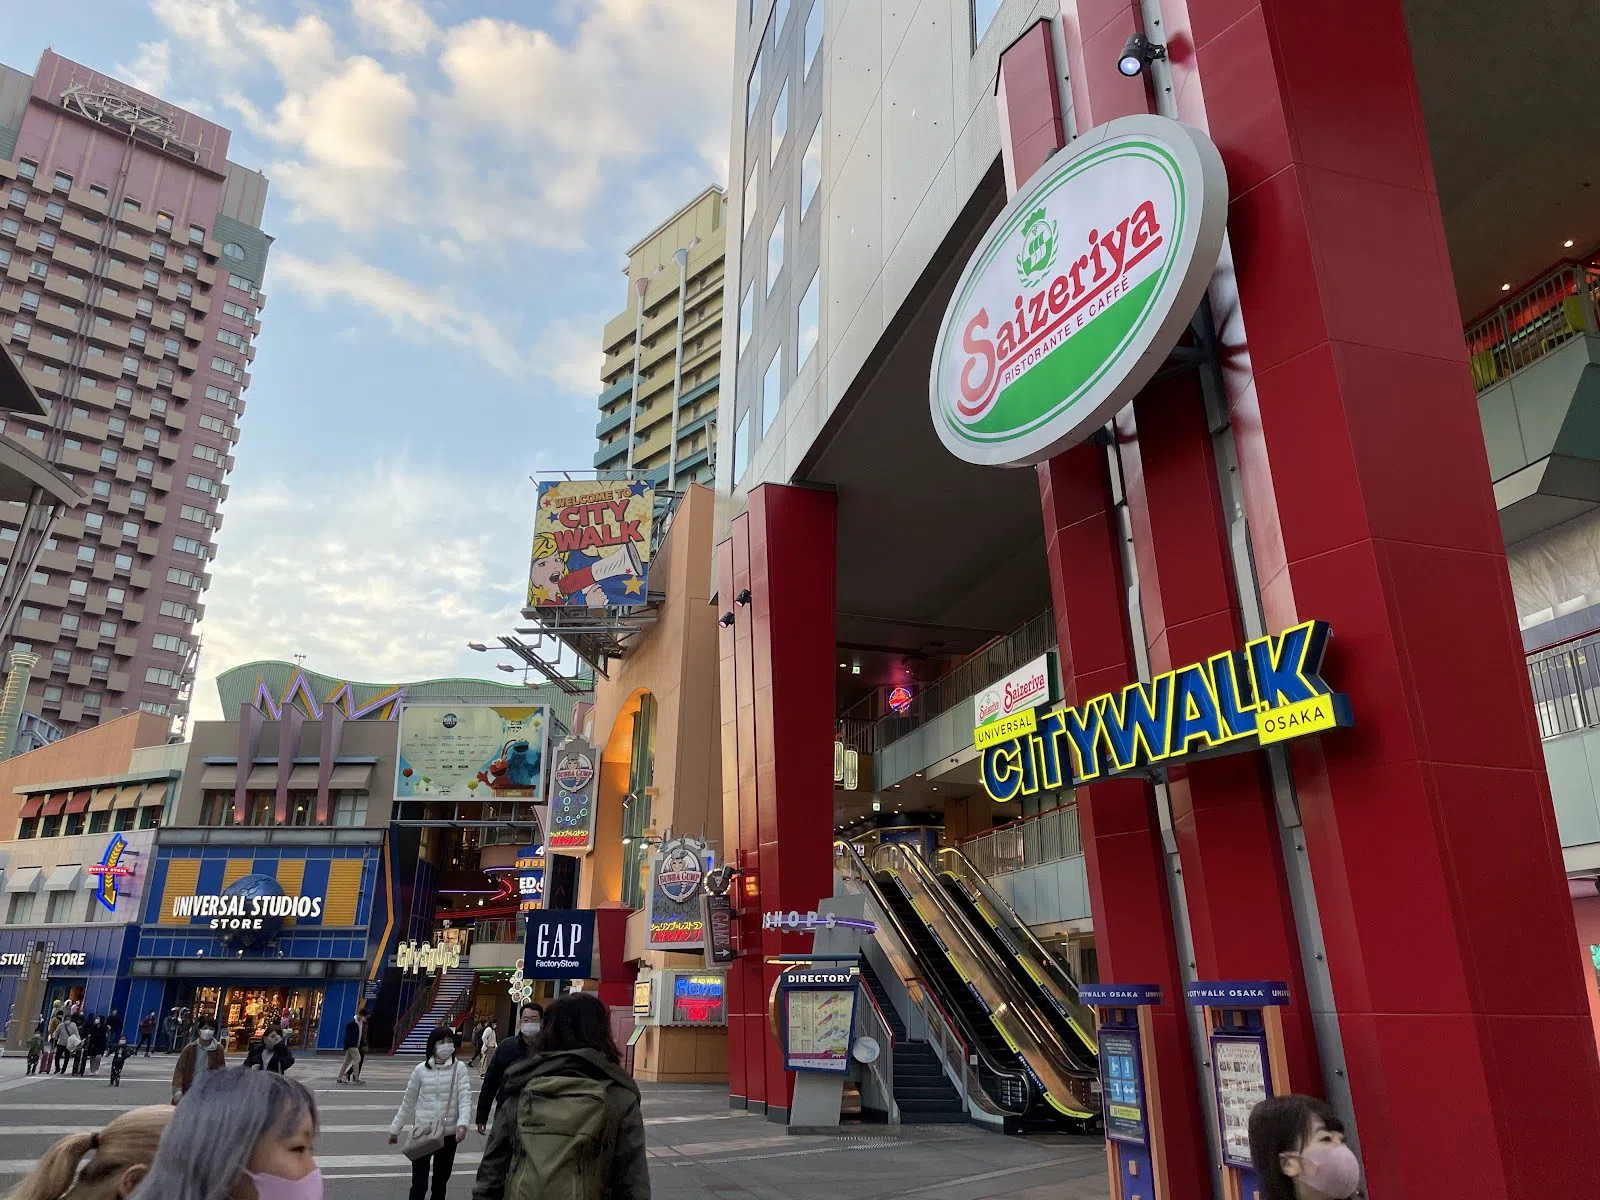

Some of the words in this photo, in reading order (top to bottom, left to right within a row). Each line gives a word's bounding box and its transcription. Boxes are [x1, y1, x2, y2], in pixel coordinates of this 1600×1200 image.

[959, 200, 1161, 405] Saizeriya
[1004, 324, 1072, 385] RISTORANTE
[1076, 315, 1085, 328] E
[1088, 275, 1130, 317] CAFFÈ
[555, 490, 614, 509] WELCOME
[615, 488, 632, 499] TO
[559, 499, 631, 529] CITY
[553, 520, 645, 552] WALK
[1003, 673, 1045, 711] Saizeriya
[981, 620, 1320, 802] CITYWALK
[1263, 706, 1326, 733] OSAKA
[978, 716, 1032, 743] UNIVERSAL
[172, 895, 246, 917] UNIVERSAL
[250, 896, 322, 917] STUDIOS
[763, 910, 836, 929] SHOPS
[209, 919, 263, 929] STORE
[536, 923, 582, 958] GAP
[788, 974, 852, 984] DIRECTORY
[1229, 989, 1264, 997] OSAKA
